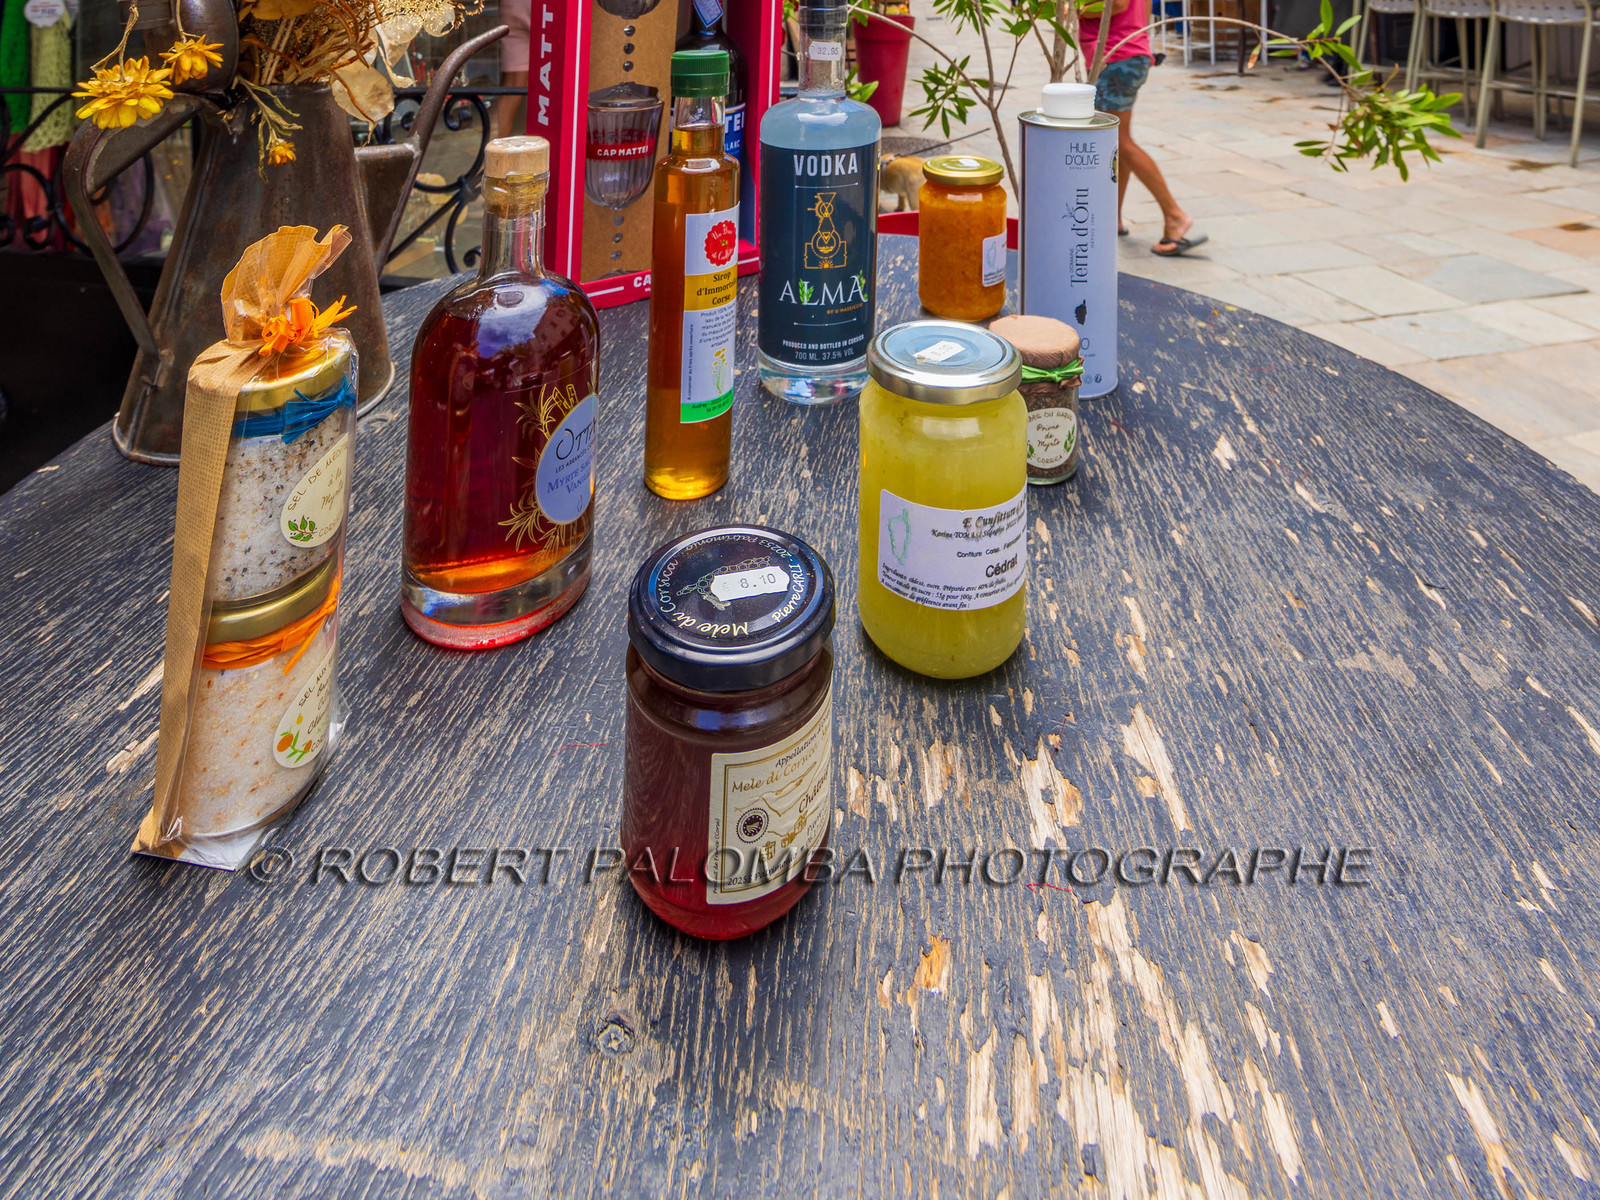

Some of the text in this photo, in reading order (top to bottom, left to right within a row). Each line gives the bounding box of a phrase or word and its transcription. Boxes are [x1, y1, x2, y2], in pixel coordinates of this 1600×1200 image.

[597, 145, 649, 157] CAP MATTEI
[1070, 141, 1097, 154] HUILE
[793, 152, 859, 178] VODKA
[1065, 154, 1100, 166] D'OLIVE
[1070, 187, 1089, 237] d'Oru
[713, 271, 731, 282] Sirop
[1070, 243, 1089, 288] Terra
[712, 294, 731, 305] Corse
[779, 275, 869, 307] ALMA
[782, 340, 807, 350] PRODUCED
[819, 341, 841, 350] BOTTLED
[795, 351, 807, 360] 700
[808, 352, 820, 361] ML.
[822, 350, 842, 361] 37.5%
[547, 467, 579, 494] MYRTE
[555, 464, 565, 474] LES
[288, 468, 322, 511] SEL DE
[931, 529, 953, 538] Karine
[686, 534, 792, 558] 20253 Patrimonio
[985, 552, 1018, 578] Cédrat
[740, 573, 777, 588] 8.10
[789, 563, 805, 593] CARLI
[656, 557, 750, 639] Mele di Corsica
[935, 591, 946, 601] 55g
[775, 733, 817, 768] Appellation
[731, 742, 818, 793] Mele di Corsica
